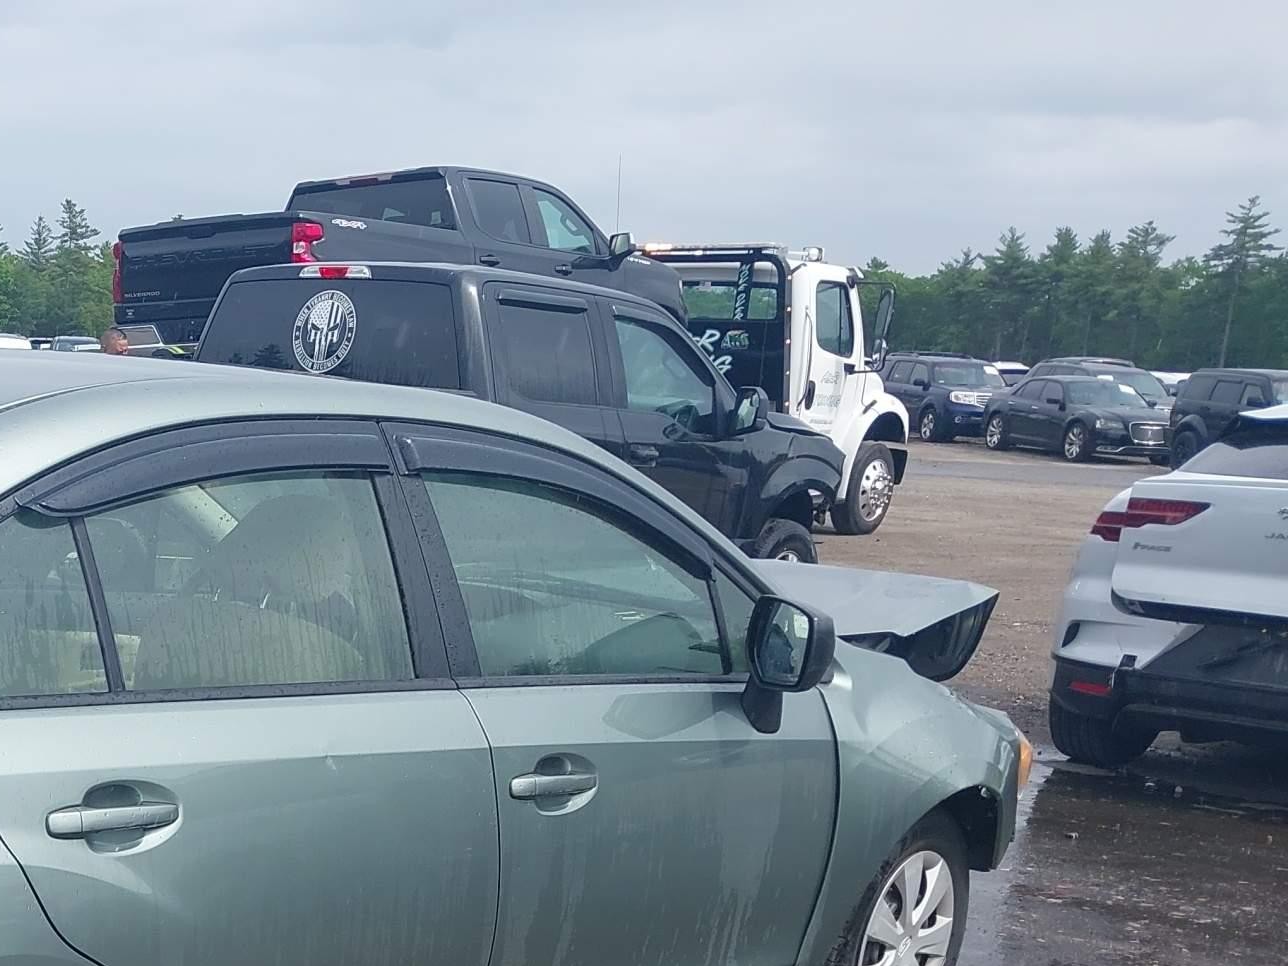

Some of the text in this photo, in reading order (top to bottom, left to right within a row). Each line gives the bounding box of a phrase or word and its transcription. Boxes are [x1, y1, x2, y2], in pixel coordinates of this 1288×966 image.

[296, 292, 355, 328] WHEN TYRANNY BECOMES LAW
[312, 356, 338, 370] BECOMES
[337, 340, 350, 358] DUTY
